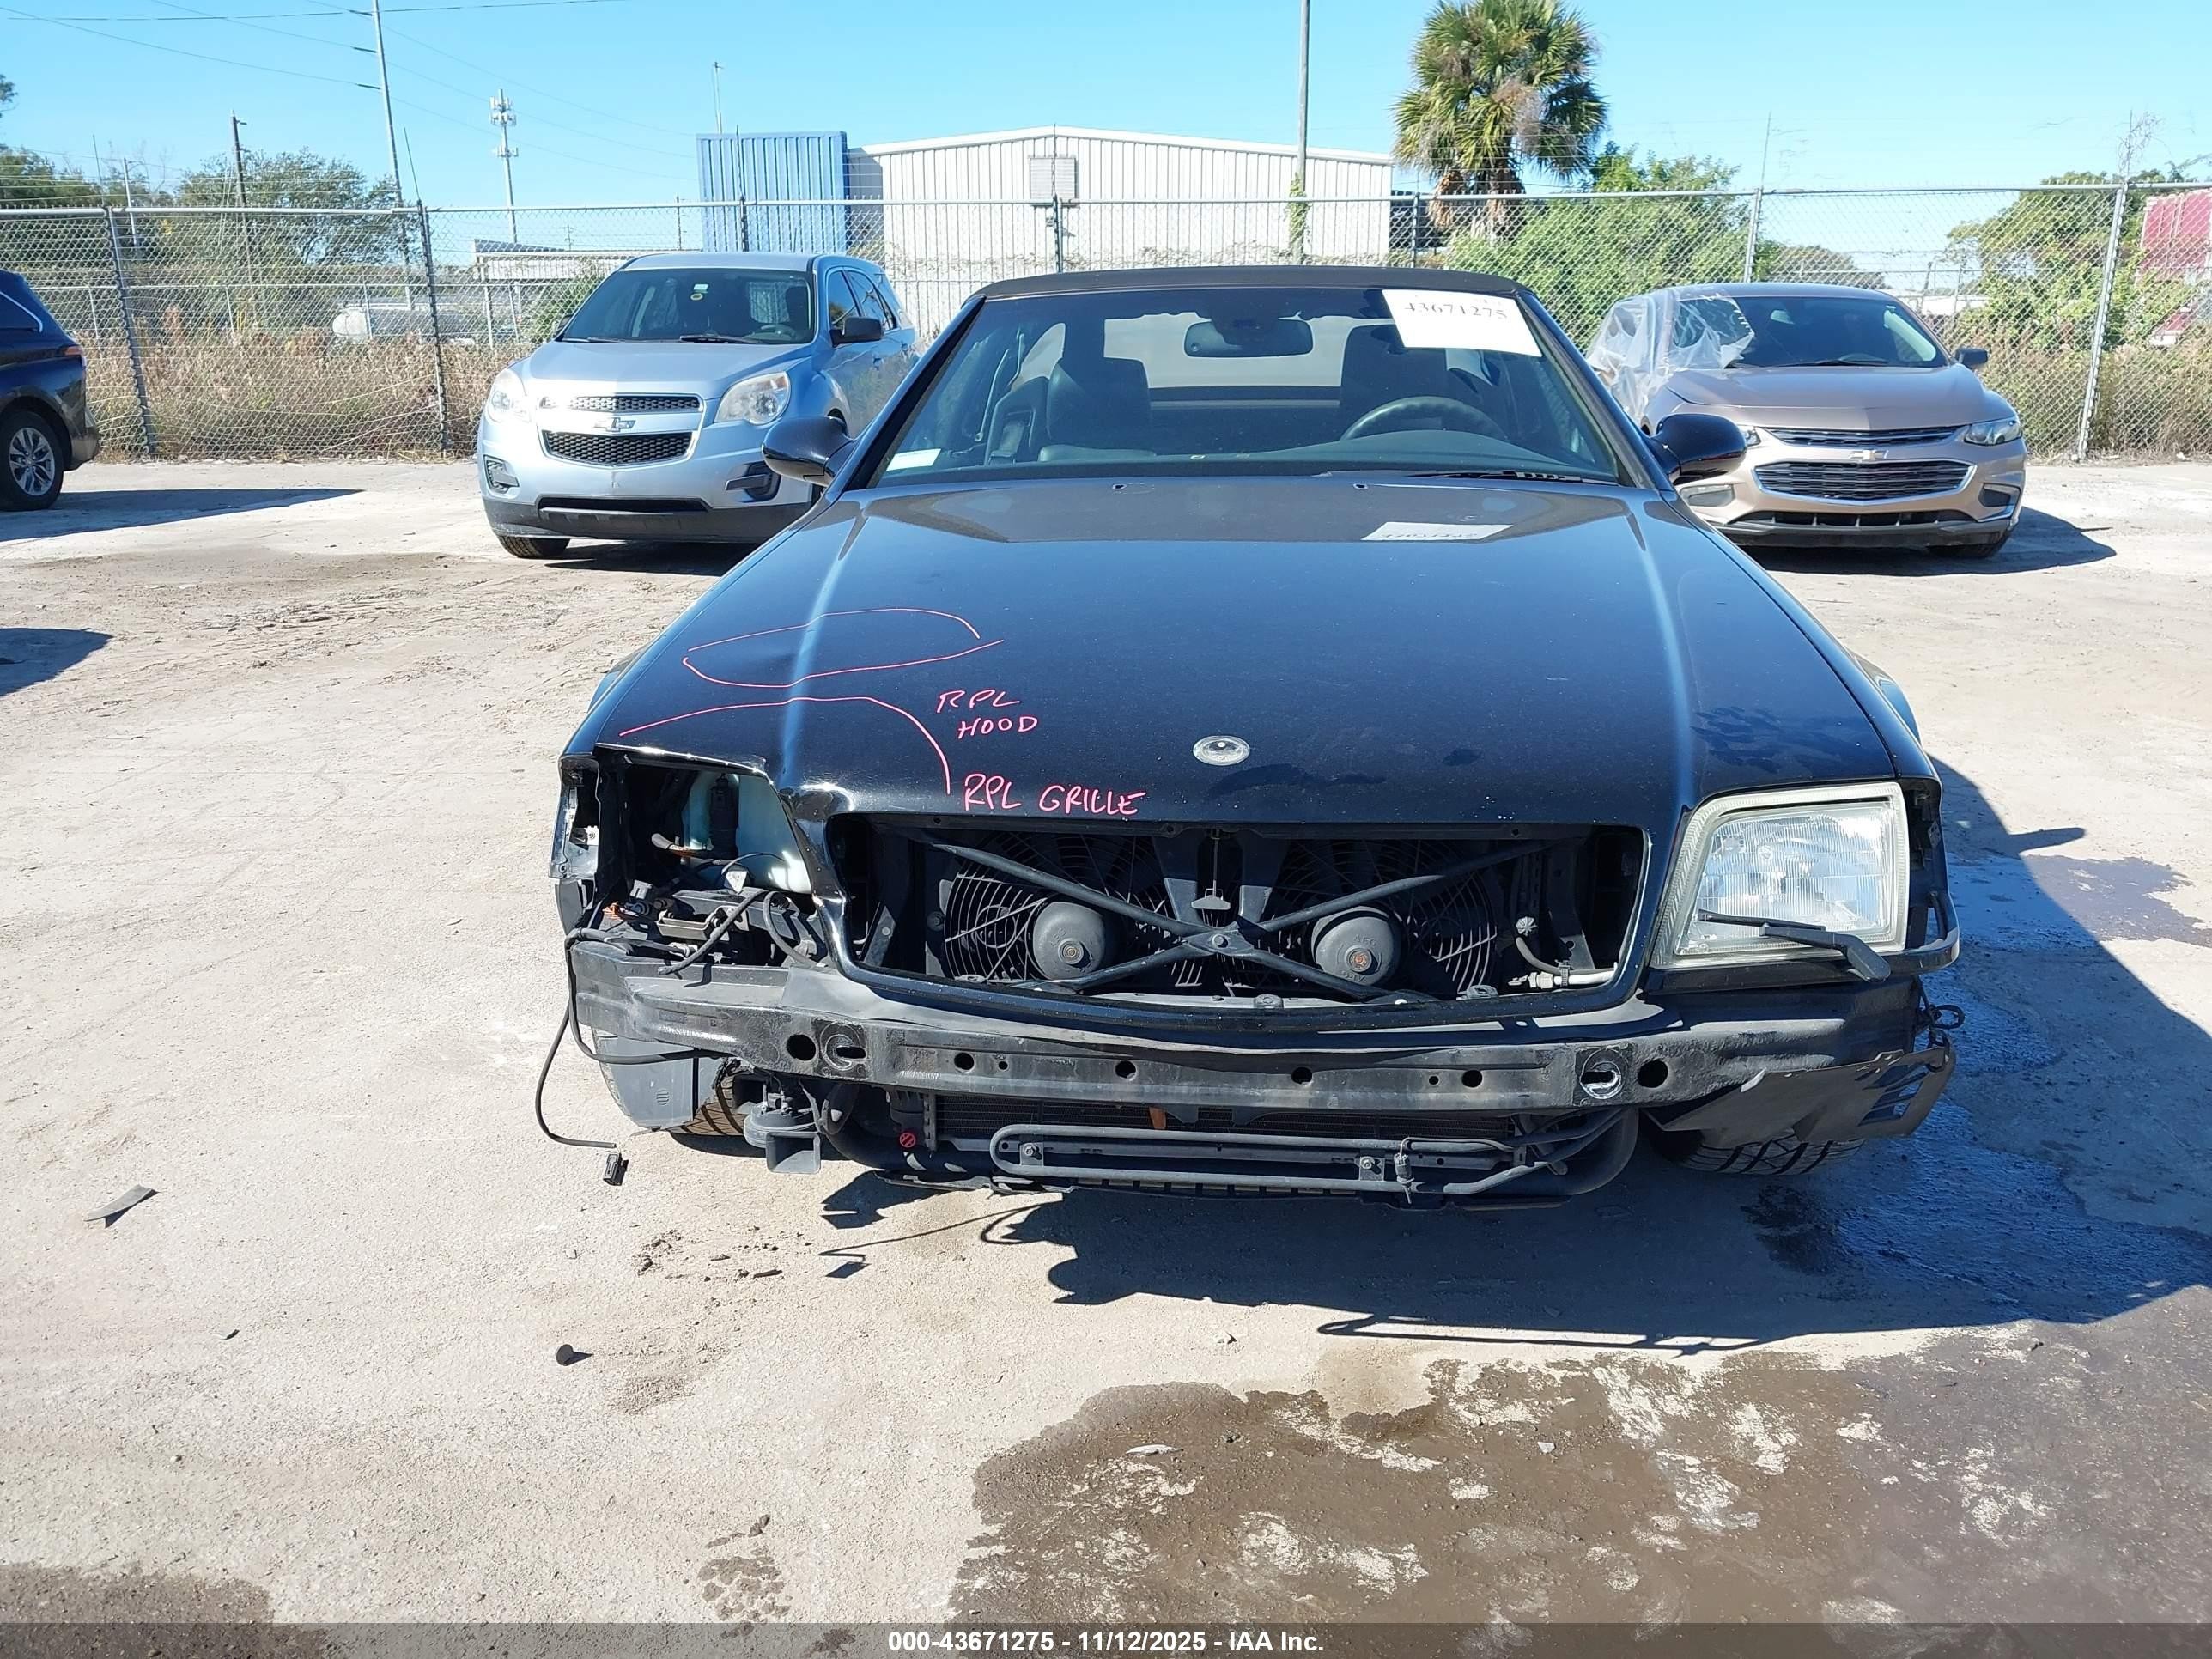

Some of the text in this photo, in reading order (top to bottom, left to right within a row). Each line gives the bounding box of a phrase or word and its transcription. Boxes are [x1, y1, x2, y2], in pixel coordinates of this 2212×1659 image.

[937, 689, 1020, 714] RPL
[957, 716, 1038, 739] HOOD
[963, 774, 1147, 816] RPL GRILLE
